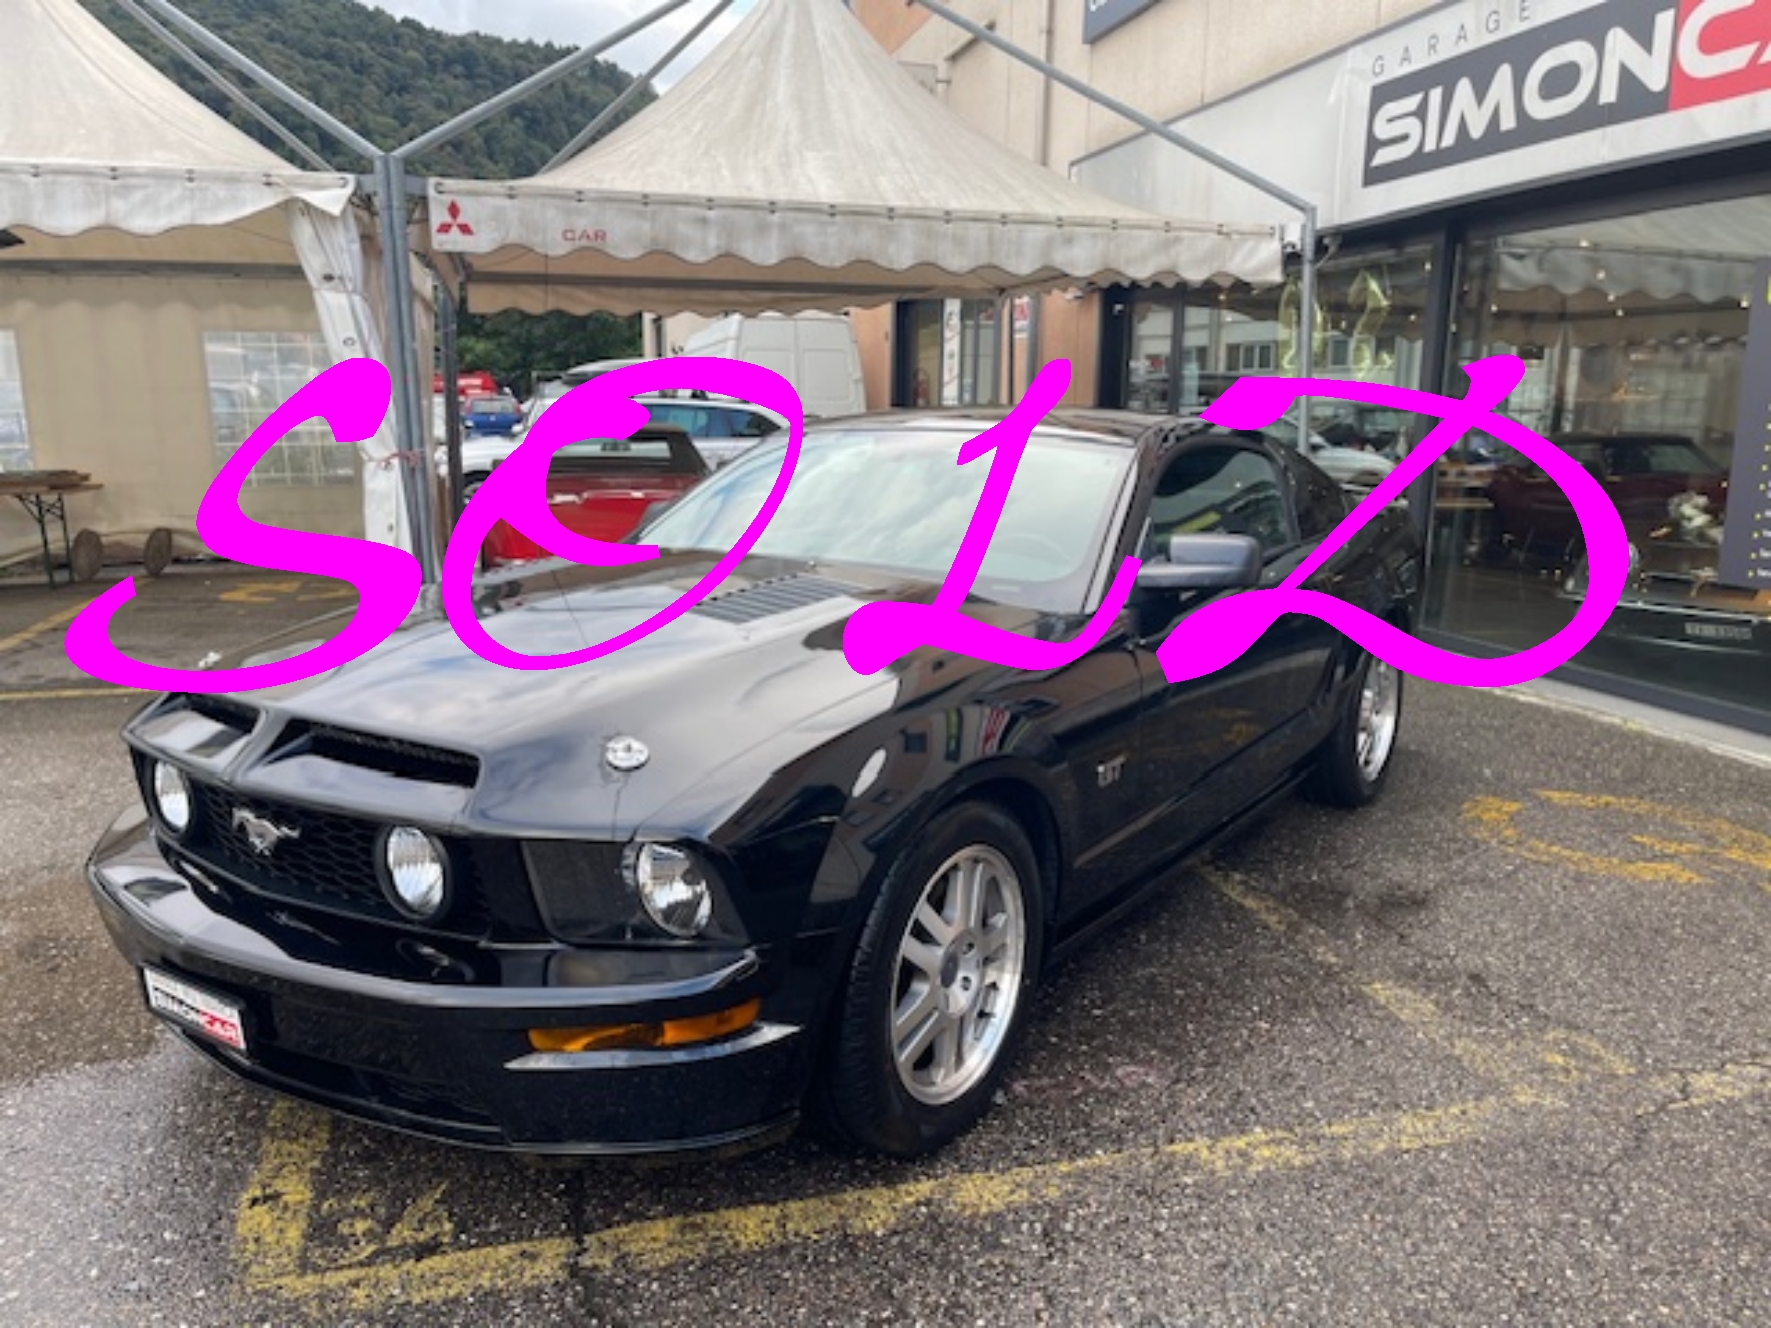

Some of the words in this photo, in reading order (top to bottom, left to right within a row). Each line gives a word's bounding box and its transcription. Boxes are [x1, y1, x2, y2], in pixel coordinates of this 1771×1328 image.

[1372, 0, 1531, 77] GARAGE
[1370, 0, 1771, 167] SIMONC
[561, 228, 607, 242] CAR
